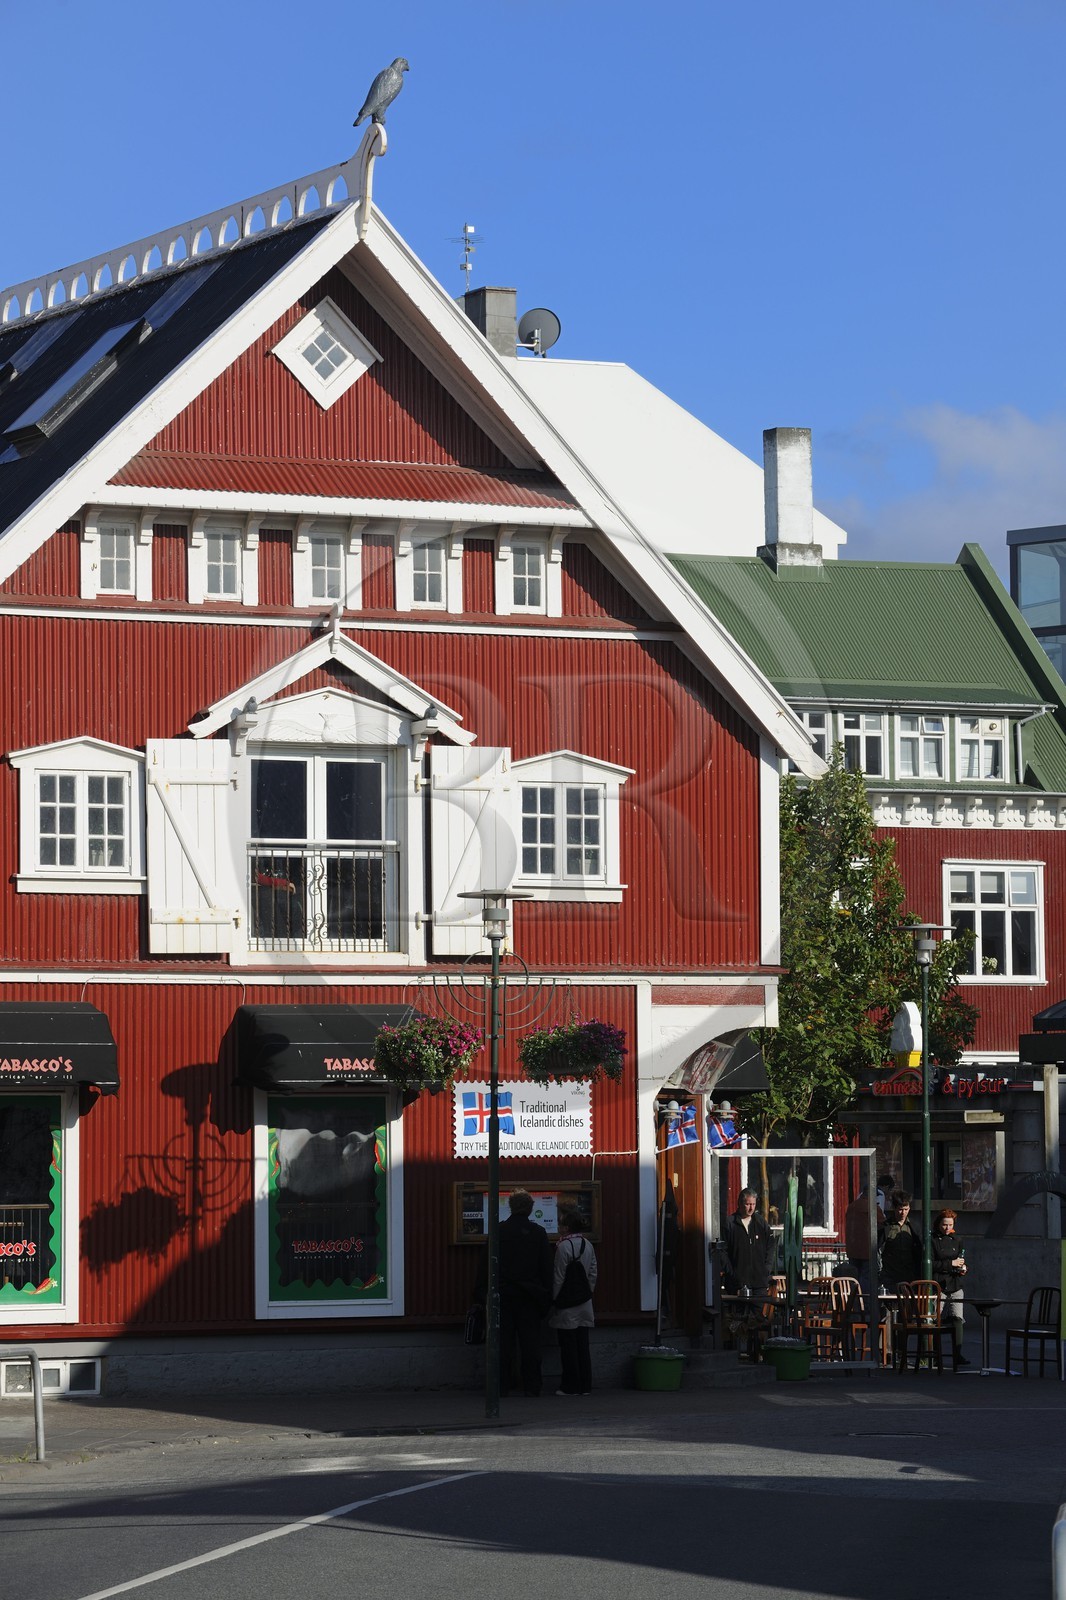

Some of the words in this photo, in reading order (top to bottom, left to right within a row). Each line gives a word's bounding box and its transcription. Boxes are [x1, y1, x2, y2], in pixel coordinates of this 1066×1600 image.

[0, 1056, 73, 1072] ABASCO'S
[324, 1058, 377, 1071] TABASC
[520, 1100, 567, 1113] Traditional
[520, 1115, 556, 1128] Icelandic
[557, 1115, 584, 1128] dishes
[460, 1142, 474, 1151] TRY
[475, 1142, 488, 1151] THE
[499, 1141, 534, 1151] ADITIONAL
[535, 1141, 569, 1151] ICELANDIC
[570, 1140, 589, 1150] FOOD
[0, 1239, 37, 1256] SCO'S
[292, 1236, 363, 1253] TABASCO'S
